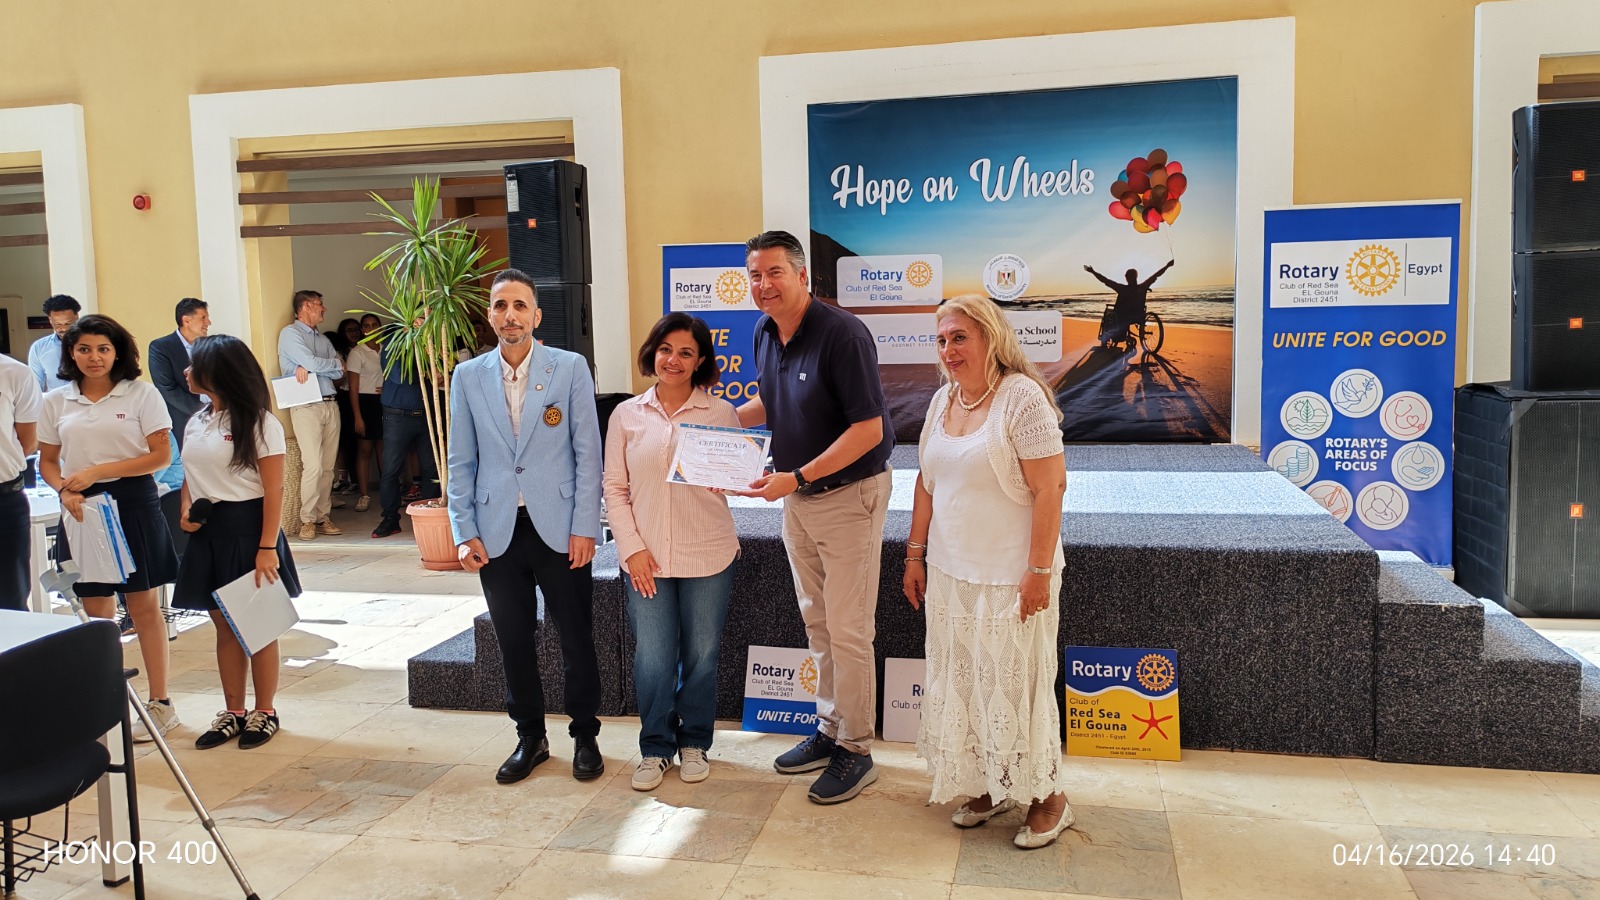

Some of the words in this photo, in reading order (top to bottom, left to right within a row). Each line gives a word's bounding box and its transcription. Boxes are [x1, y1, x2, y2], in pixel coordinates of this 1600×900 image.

[830, 164, 914, 216] Hope
[922, 176, 959, 202] on
[969, 155, 1096, 203] Wheels
[861, 269, 903, 282] Rotary
[1279, 263, 1339, 281] Rotary
[1408, 263, 1443, 277] Egypt
[675, 282, 712, 294] Rotary
[845, 284, 863, 292] Club
[863, 284, 871, 292] of
[872, 284, 887, 292] Red
[1279, 282, 1297, 290] Club
[1324, 281, 1339, 289] Sea
[879, 293, 903, 301] Gouna
[1293, 296, 1318, 304] District
[1320, 295, 1339, 303] 2451
[1025, 325, 1057, 335] School
[877, 334, 937, 343] GARAGE
[1272, 331, 1327, 348] UNITE
[1332, 330, 1374, 348] FOR
[1378, 330, 1447, 347] GOOD
[714, 354, 743, 373] OR
[707, 381, 760, 400] GOO
[1325, 437, 1388, 449] ROTARY'S
[1325, 449, 1367, 460] AREAS
[1370, 449, 1388, 460] OF
[1335, 461, 1378, 471] FOCUS
[752, 663, 795, 680] Rotary
[1072, 660, 1132, 682] Rotary
[891, 699, 910, 710] Club
[912, 700, 921, 710] of
[1069, 697, 1088, 705] Club
[1091, 698, 1100, 706] of
[756, 709, 792, 723] UNITE
[792, 712, 818, 725] FOR
[1070, 707, 1094, 718] Red
[1099, 708, 1121, 719] Sea
[1070, 719, 1081, 729] El
[1085, 720, 1127, 732] Gouna
